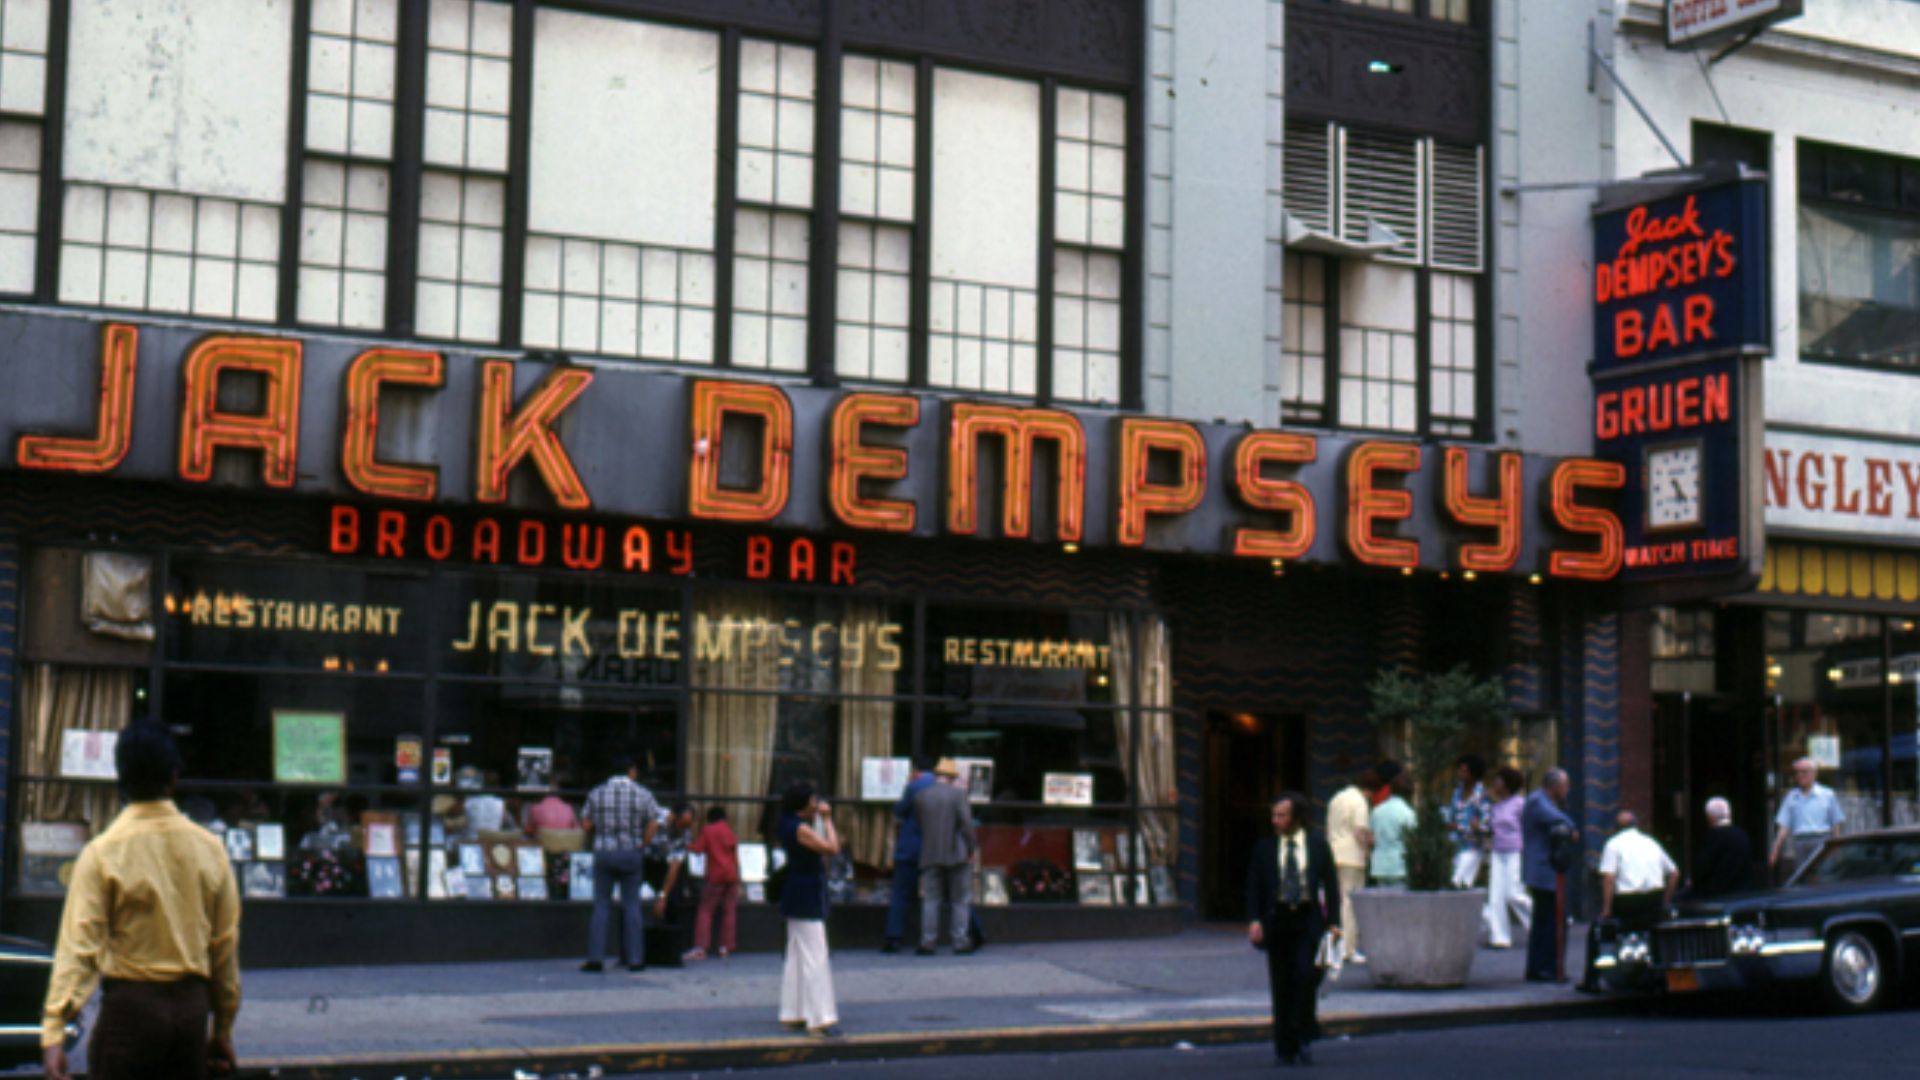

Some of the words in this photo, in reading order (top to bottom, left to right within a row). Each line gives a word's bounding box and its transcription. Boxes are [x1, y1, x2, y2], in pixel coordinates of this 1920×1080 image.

[1618, 195, 1704, 258] Jack
[1596, 229, 1735, 304] DEMPSEY'S
[1614, 293, 1714, 358] BAR
[1596, 372, 1730, 440] GRUEN
[17, 323, 593, 508] JACK
[689, 379, 1627, 580] DEMPSEYS
[330, 505, 693, 575] BROADWAY
[747, 536, 856, 584] BAR
[1691, 537, 1738, 561] TIME
[191, 595, 401, 636] RESTAURANT
[452, 601, 592, 657] JACK
